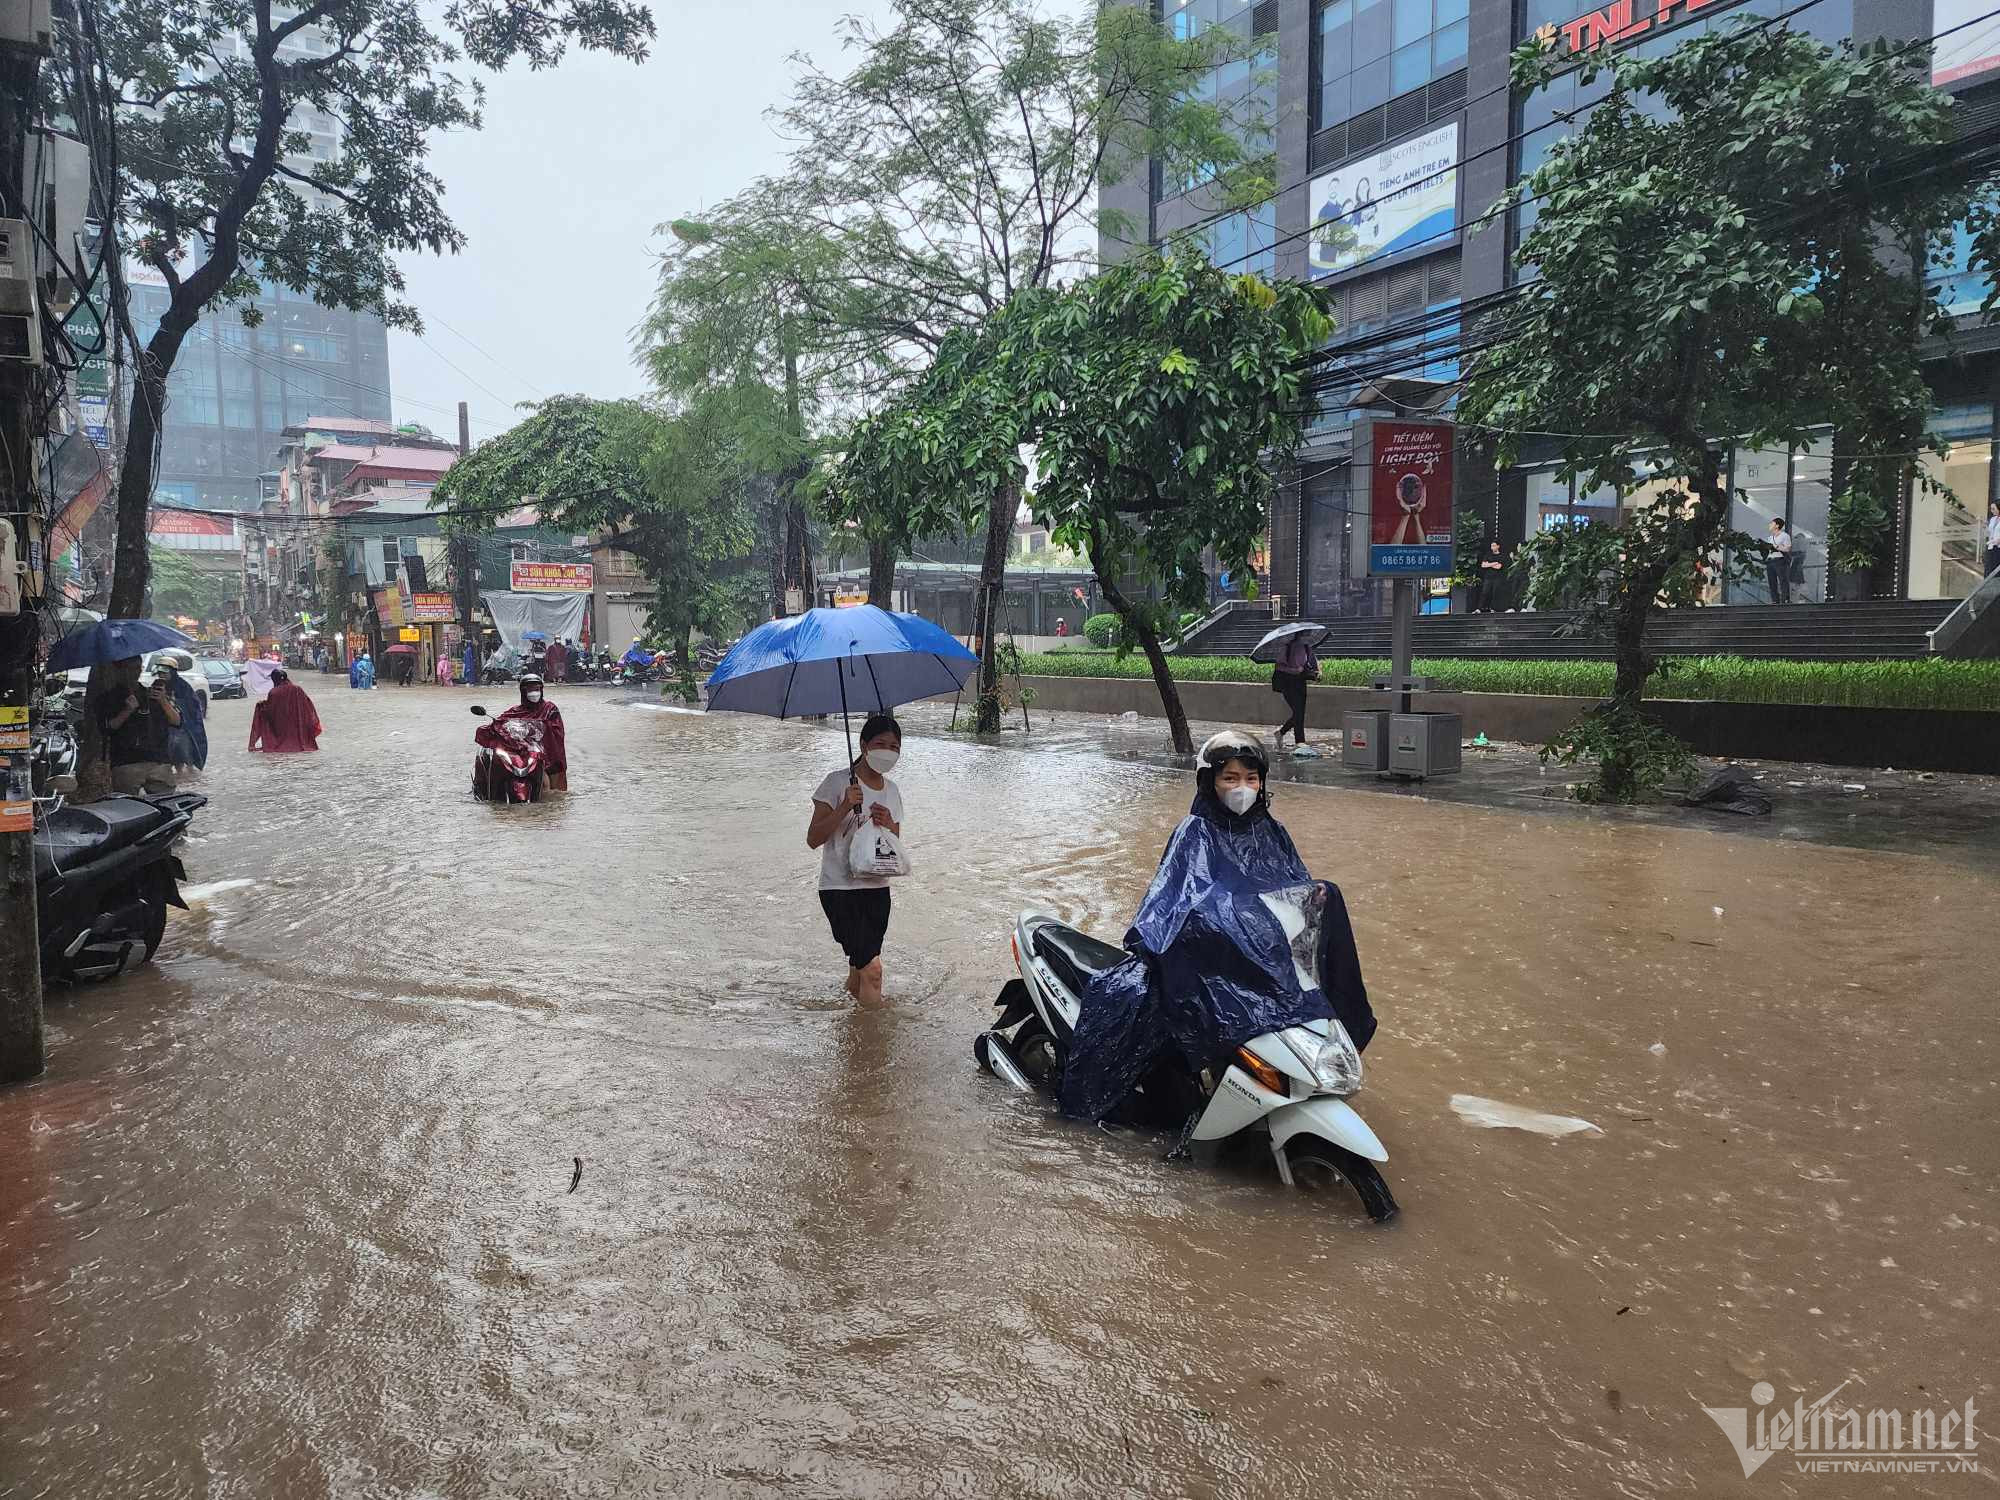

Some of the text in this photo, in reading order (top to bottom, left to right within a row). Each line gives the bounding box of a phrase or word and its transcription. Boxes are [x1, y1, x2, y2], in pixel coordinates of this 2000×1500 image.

[1561, 0, 1651, 53] TNL
[1439, 156, 1450, 168] EM
[1393, 430, 1434, 443] TIẾT KIỆM
[1227, 1077, 1262, 1106] HONDA
